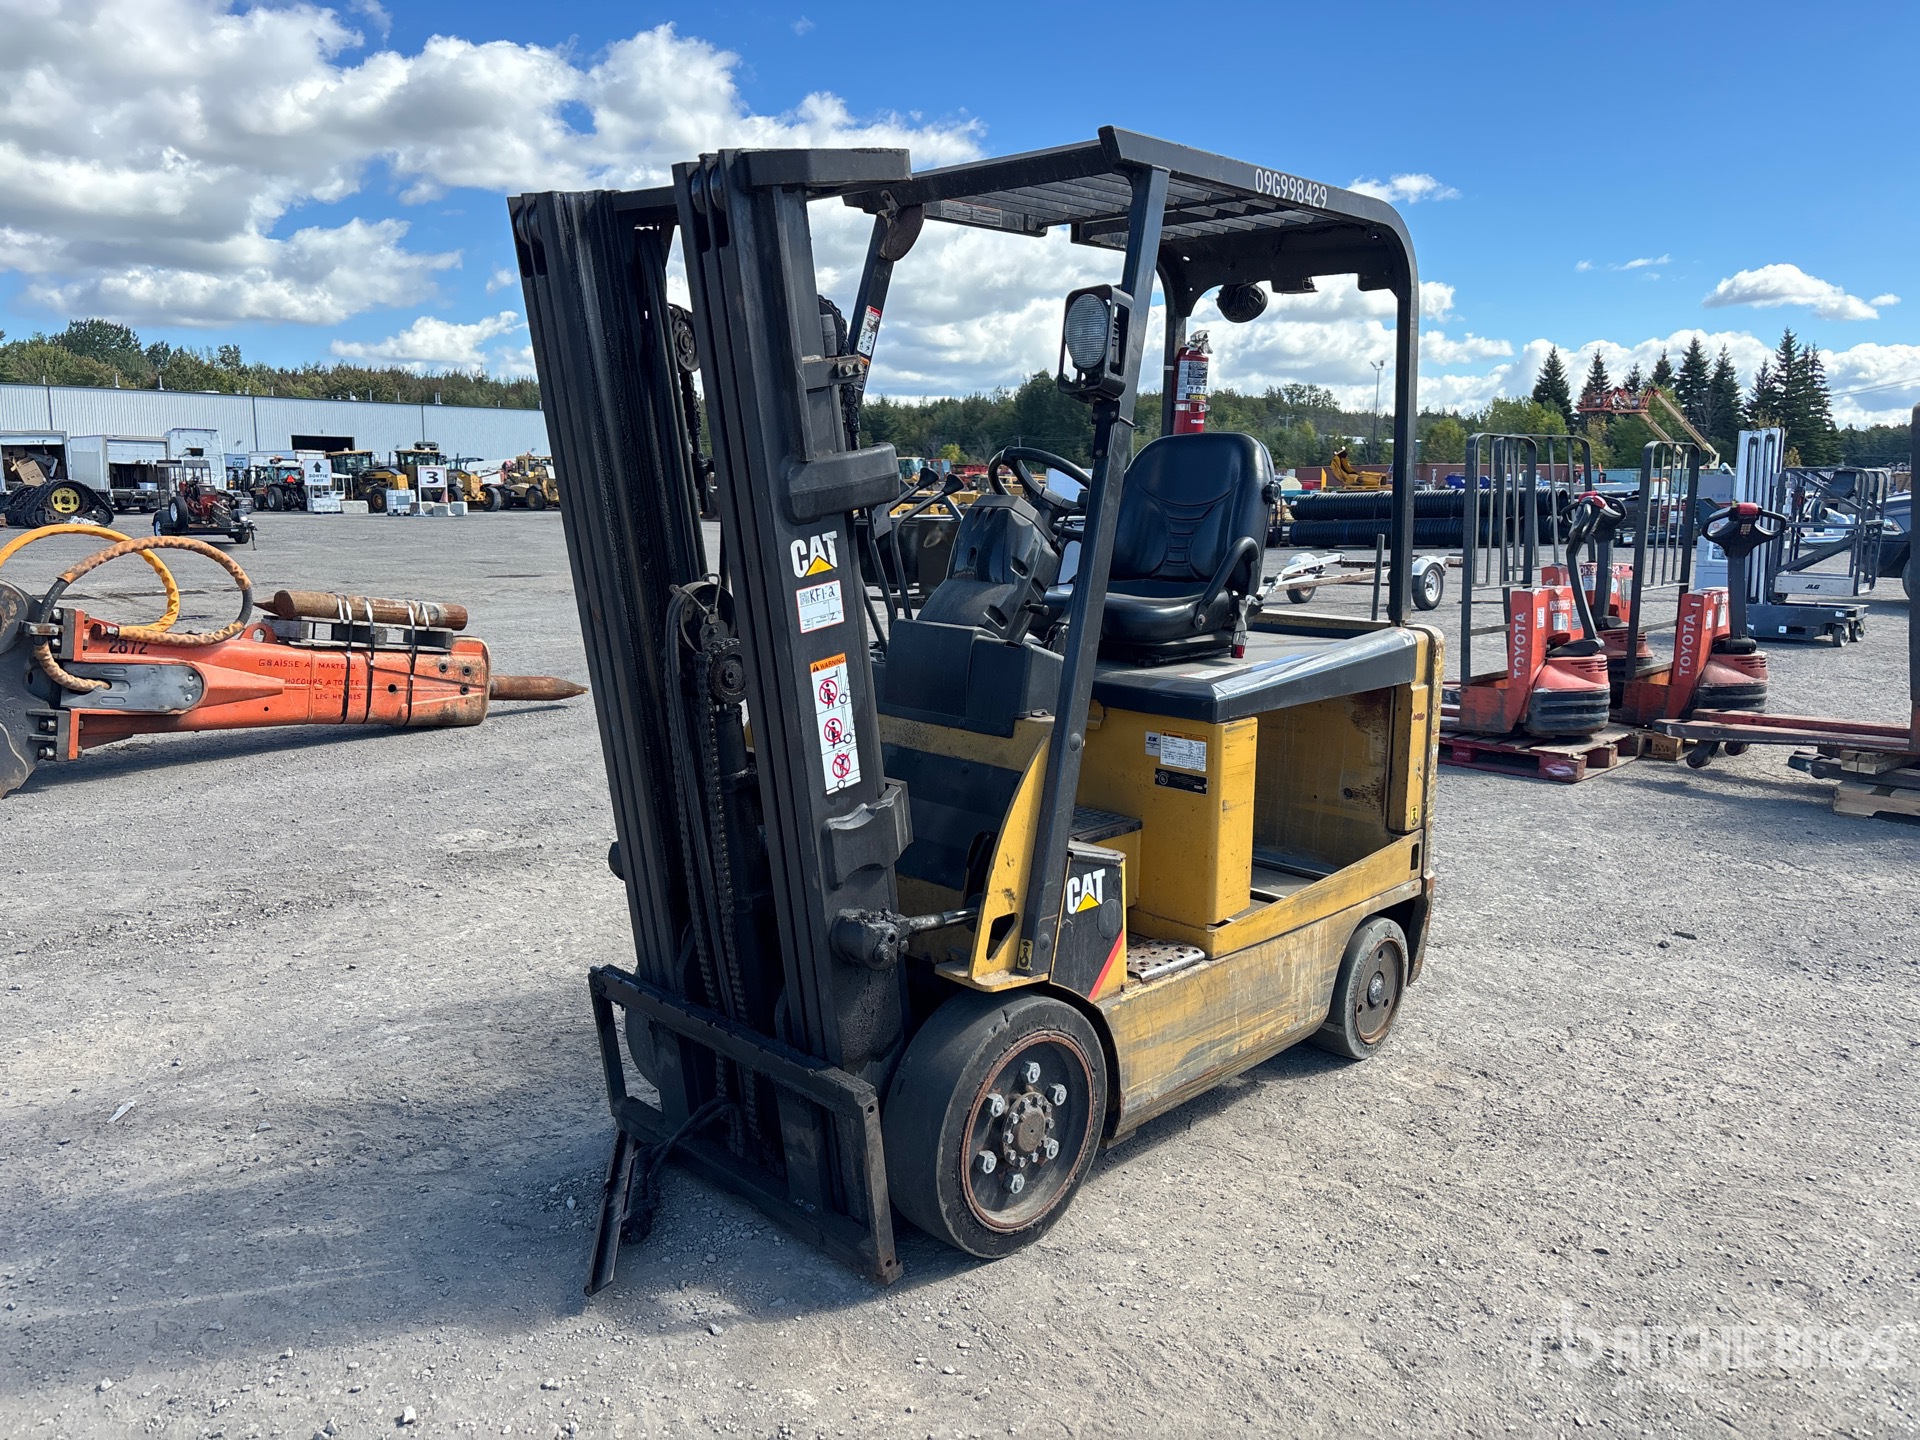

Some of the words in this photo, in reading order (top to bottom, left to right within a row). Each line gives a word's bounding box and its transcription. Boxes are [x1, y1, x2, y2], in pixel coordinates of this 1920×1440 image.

[1255, 168, 1327, 209] 09G998429
[426, 471, 439, 484] 3
[790, 530, 838, 578] CAT
[108, 640, 149, 655] 2872
[258, 658, 300, 668] GRAISSE
[318, 662, 357, 670] MARTEU
[819, 656, 845, 670] WARNING
[1513, 611, 1527, 679] TOYOTA
[1678, 613, 1697, 677] TOYOTA
[1066, 868, 1106, 915] CAT
